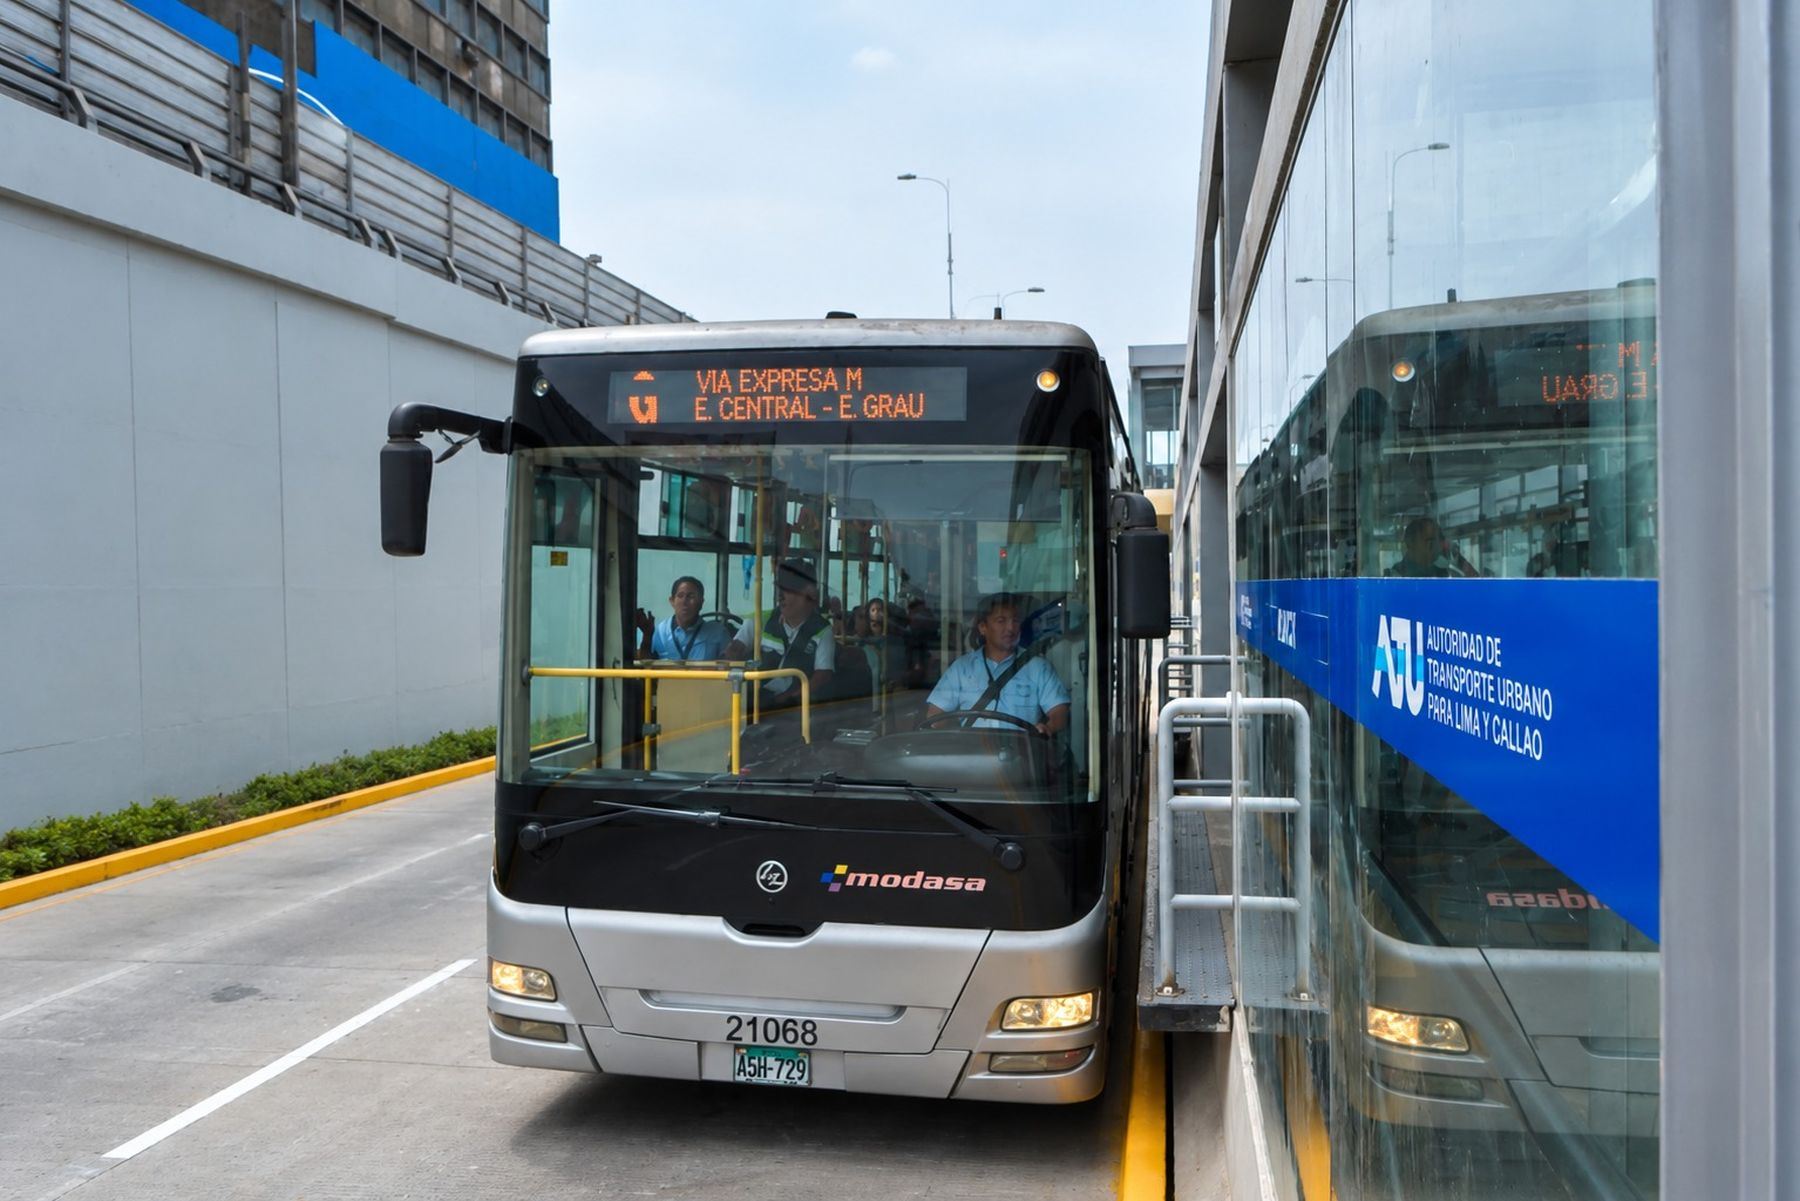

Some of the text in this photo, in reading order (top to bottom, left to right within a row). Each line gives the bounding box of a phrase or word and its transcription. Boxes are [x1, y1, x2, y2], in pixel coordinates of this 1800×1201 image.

[696, 366, 863, 394] VIA EXPRESA M
[695, 396, 713, 421] E.
[719, 394, 817, 420] CENTRAL
[839, 393, 858, 419] E.
[862, 392, 925, 419] GRAU
[1426, 624, 1502, 667] AUTORIDAD DE
[1371, 614, 1425, 717] ATU
[1427, 657, 1553, 722] TRANSPORTE URBANO
[1427, 692, 1543, 761] PARA LIMA Y CALLAO
[845, 871, 987, 892] modasa
[726, 1015, 818, 1046] 21068
[736, 1054, 806, 1081] A5H-729
